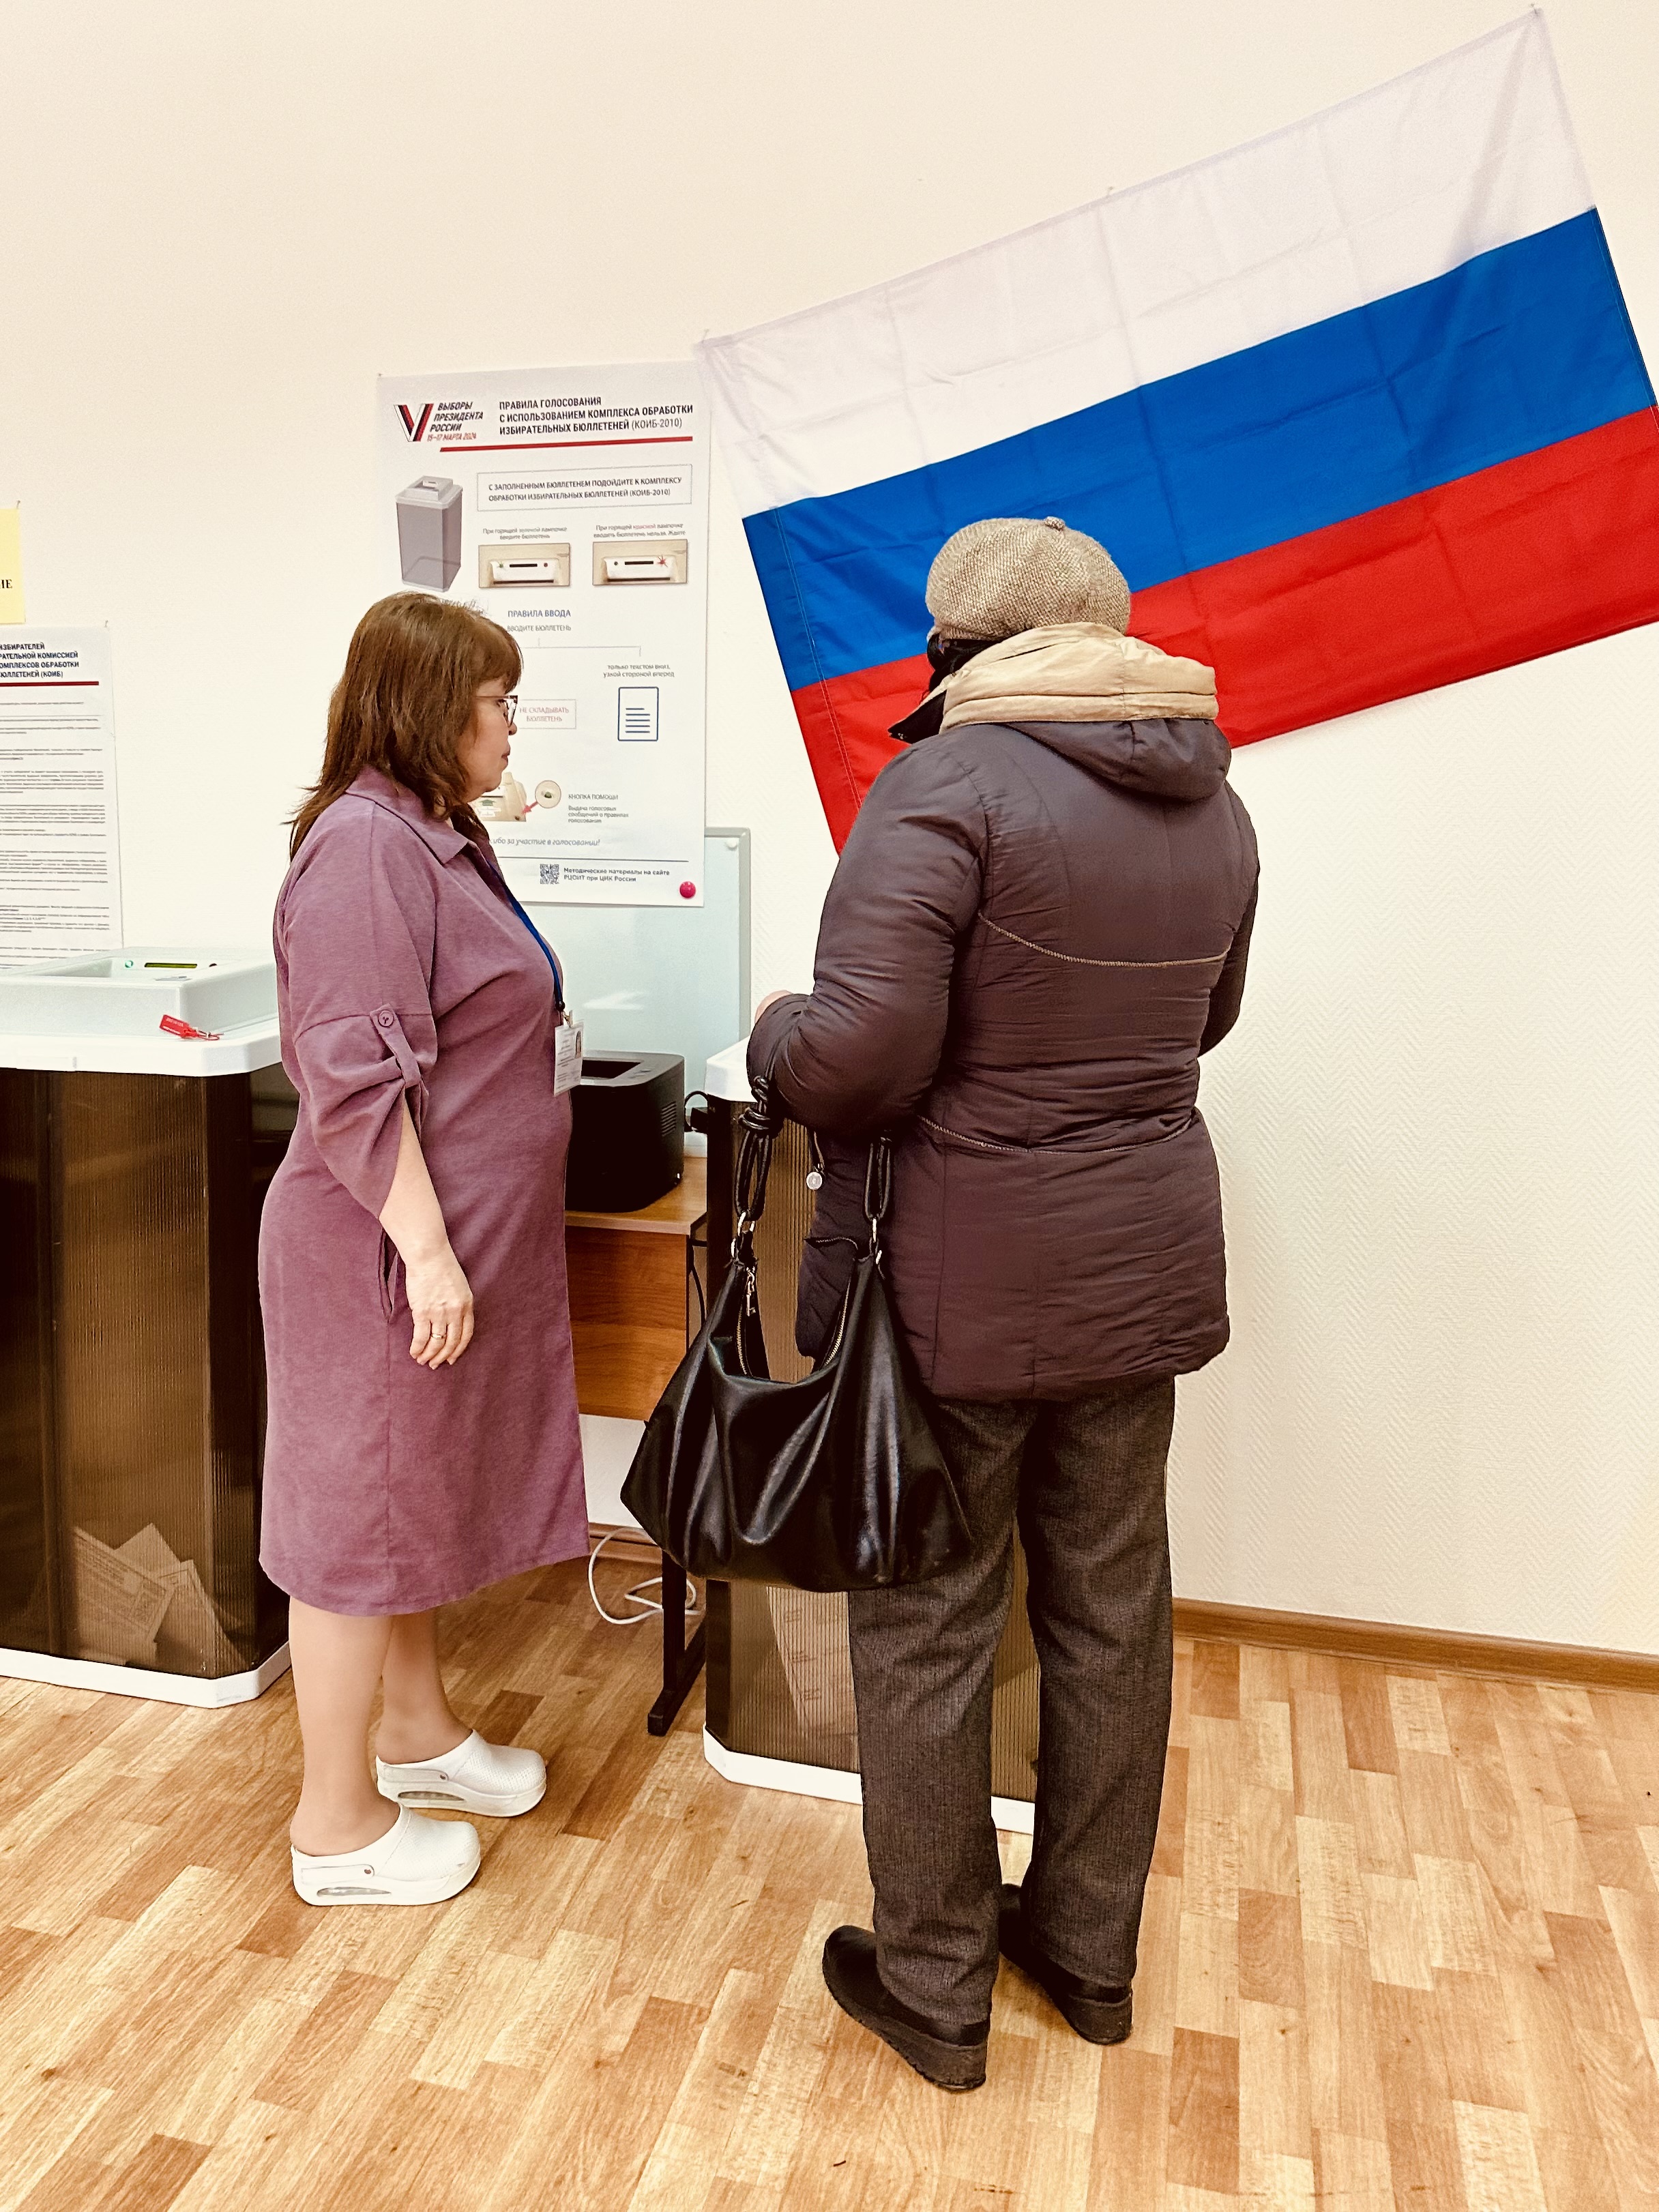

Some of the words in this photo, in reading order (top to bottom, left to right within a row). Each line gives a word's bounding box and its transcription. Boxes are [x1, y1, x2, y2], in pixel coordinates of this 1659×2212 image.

[438, 402, 473, 411] ВЫБОРЫ
[499, 400, 538, 410] ПРАВИЛА
[541, 397, 601, 408] ГОЛОСОВАНИЯ
[434, 411, 483, 422] ПРЕЗИДЕНТА
[508, 409, 585, 422] ИСПОЛЬЗОВАНИЕМ
[588, 408, 640, 418] КОМПЛЕКСА
[643, 404, 692, 415] ОБРАБОТКИ
[430, 423, 462, 432] РОССИИ
[500, 424, 571, 435] ИЗБИРАТЕЛЬНЫХ
[574, 418, 629, 432] БЮЛЛЕТЕНЕЙ
[632, 417, 681, 431] (КОИБ-2010)
[495, 482, 545, 490] ЗАПОЛНЕННЫМ
[592, 479, 633, 487] ПОДОЙДИТЕ
[585, 489, 628, 498] БЮЛЛЕТЕНЕЙ
[630, 488, 670, 497] (КОИБ-2010)
[545, 610, 571, 618] ВВОДА
[38, 651, 78, 659] КОМИССИЕЙ
